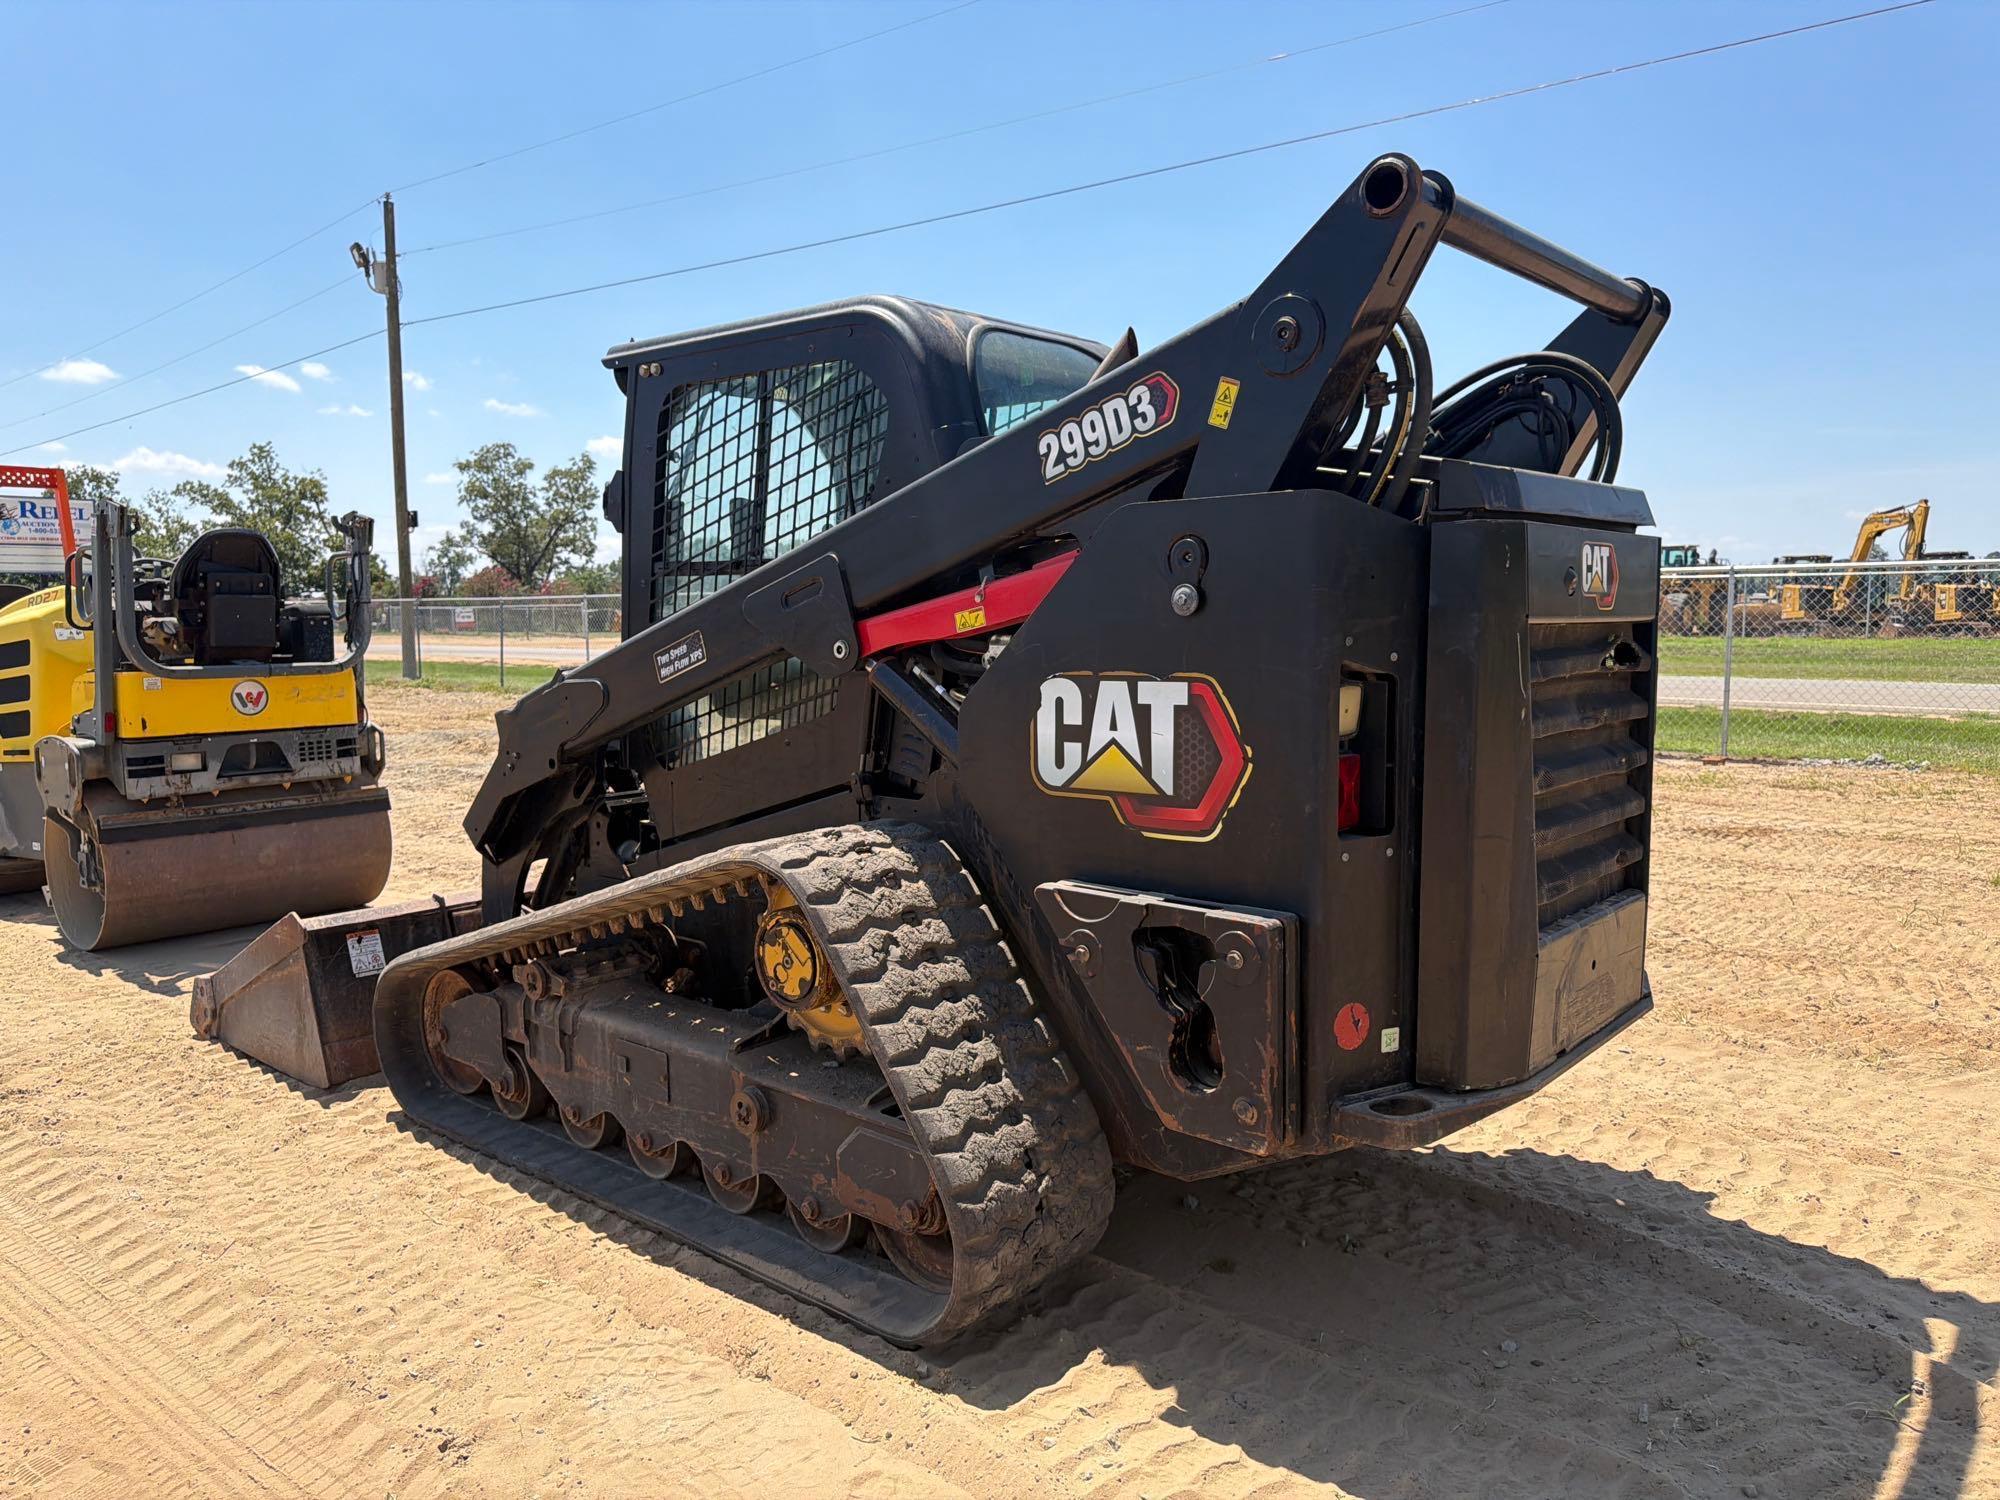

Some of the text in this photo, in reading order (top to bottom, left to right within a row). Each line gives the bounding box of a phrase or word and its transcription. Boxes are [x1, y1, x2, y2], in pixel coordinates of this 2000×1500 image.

[1039, 385, 1156, 480] 299D3
[1582, 544, 1609, 592] CAT
[27, 590, 59, 607] RD27
[690, 648, 703, 663] XPS
[1037, 678, 1188, 796] CAT
